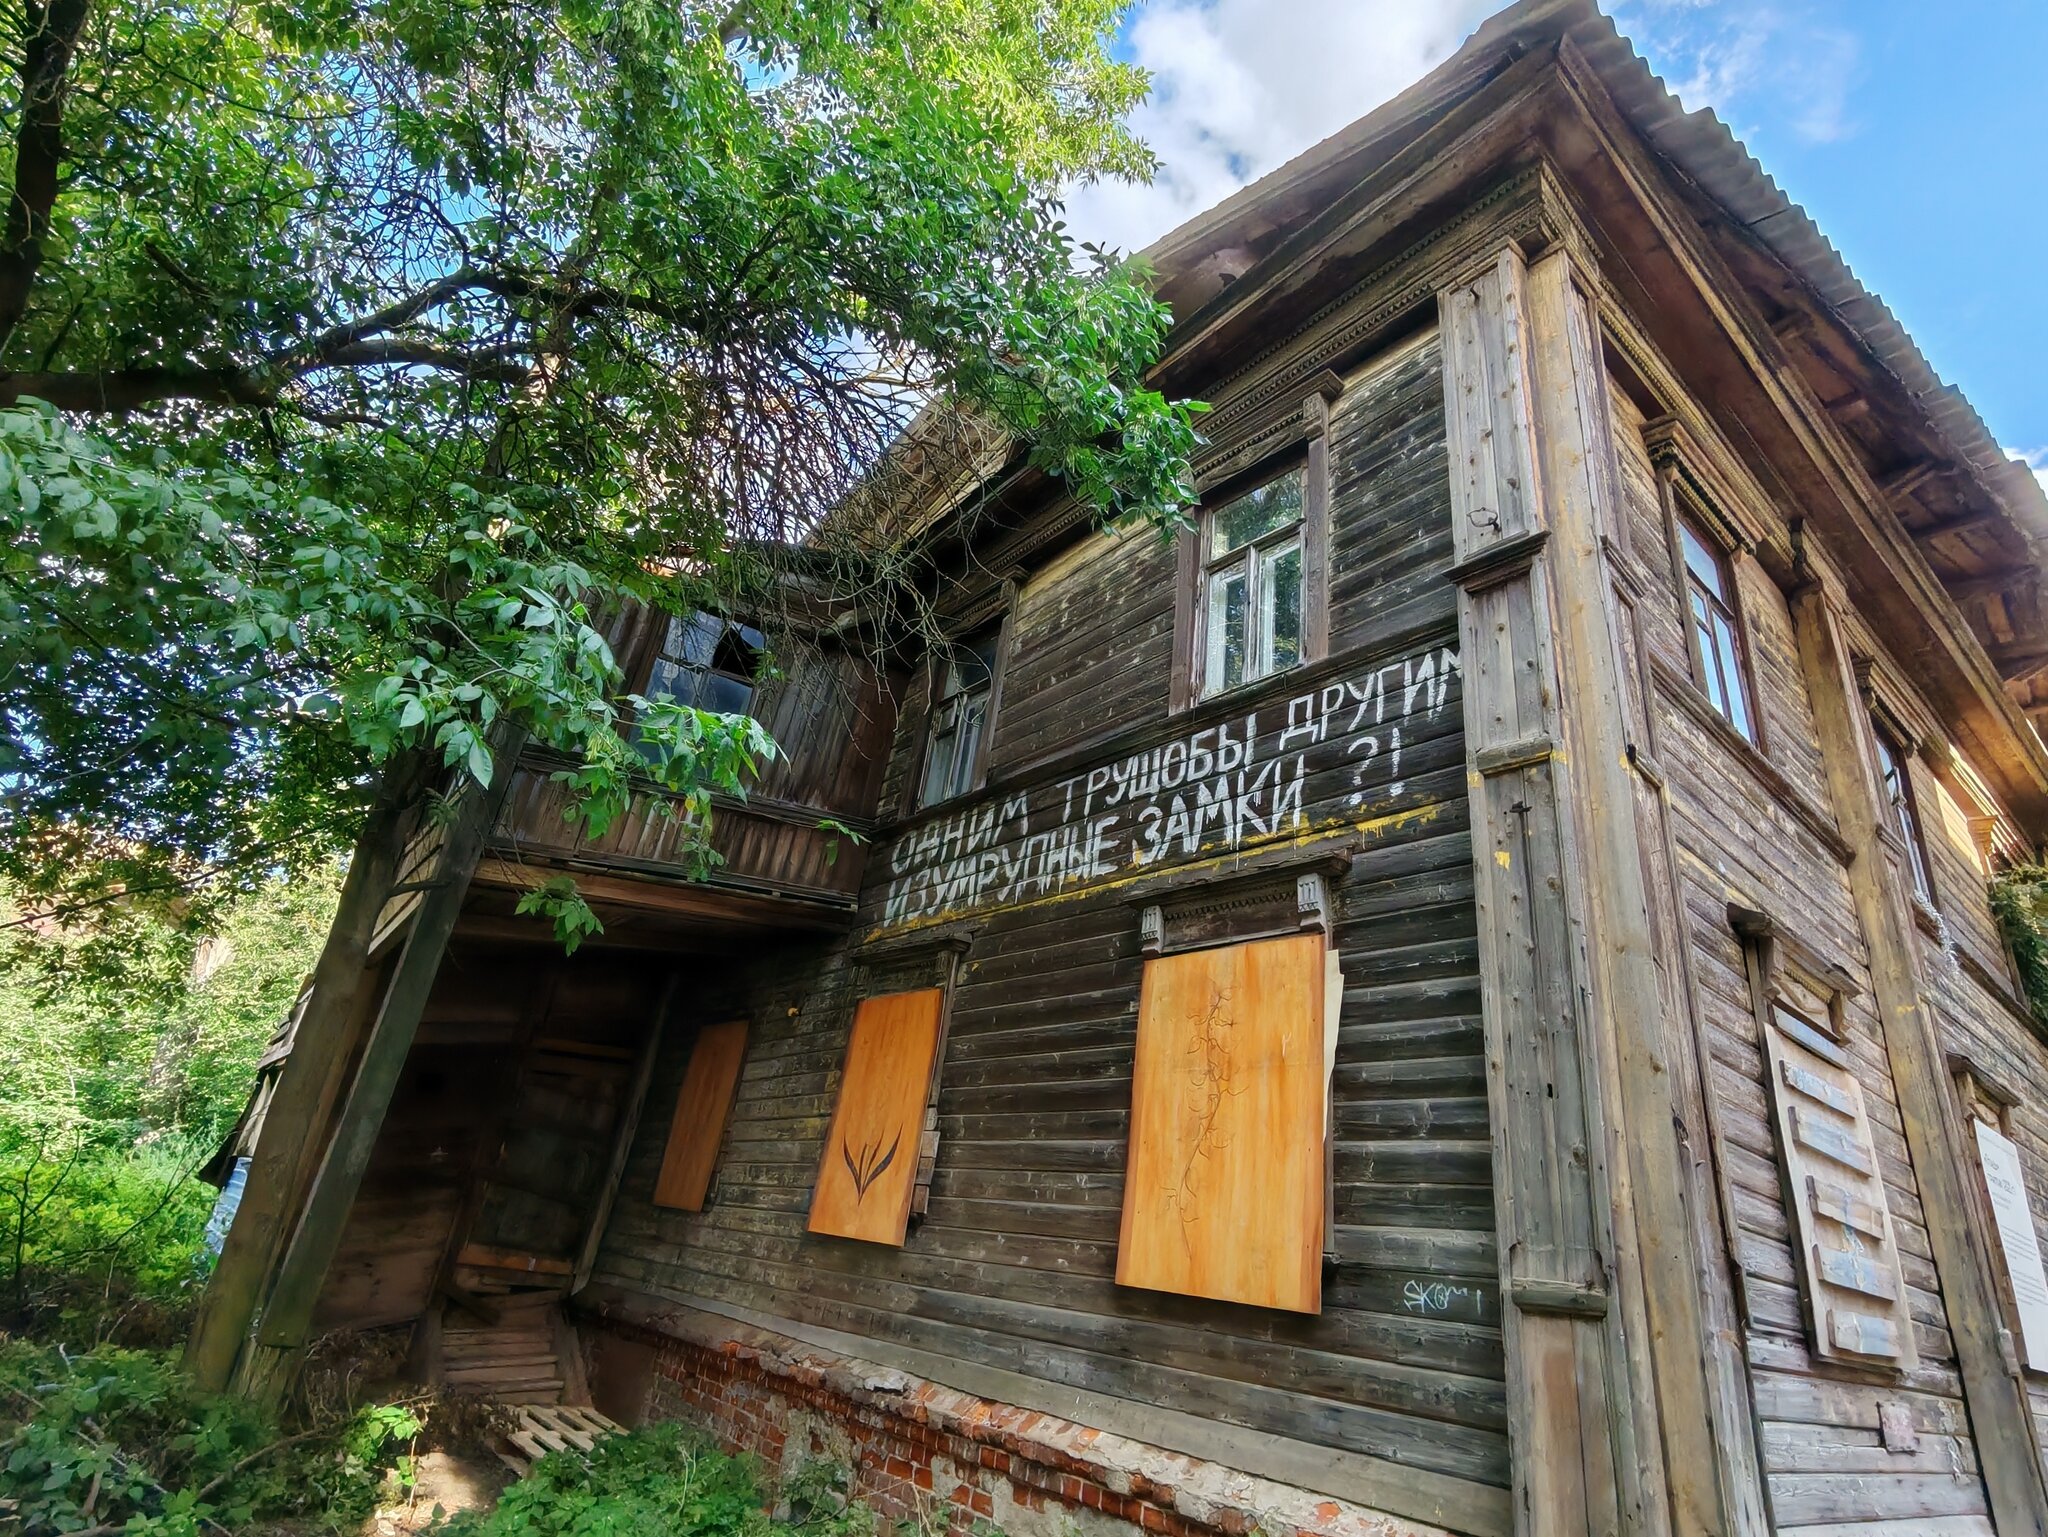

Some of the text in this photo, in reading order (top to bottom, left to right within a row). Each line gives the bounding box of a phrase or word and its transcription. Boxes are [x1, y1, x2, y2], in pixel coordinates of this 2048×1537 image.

[884, 816, 1120, 928] ИЗУМРУДНЫЕ
[1132, 754, 1305, 866] ЗАМКИ
[892, 789, 1029, 875] ОДНИМ
[1056, 713, 1257, 824] ТРУЩОБЫ
